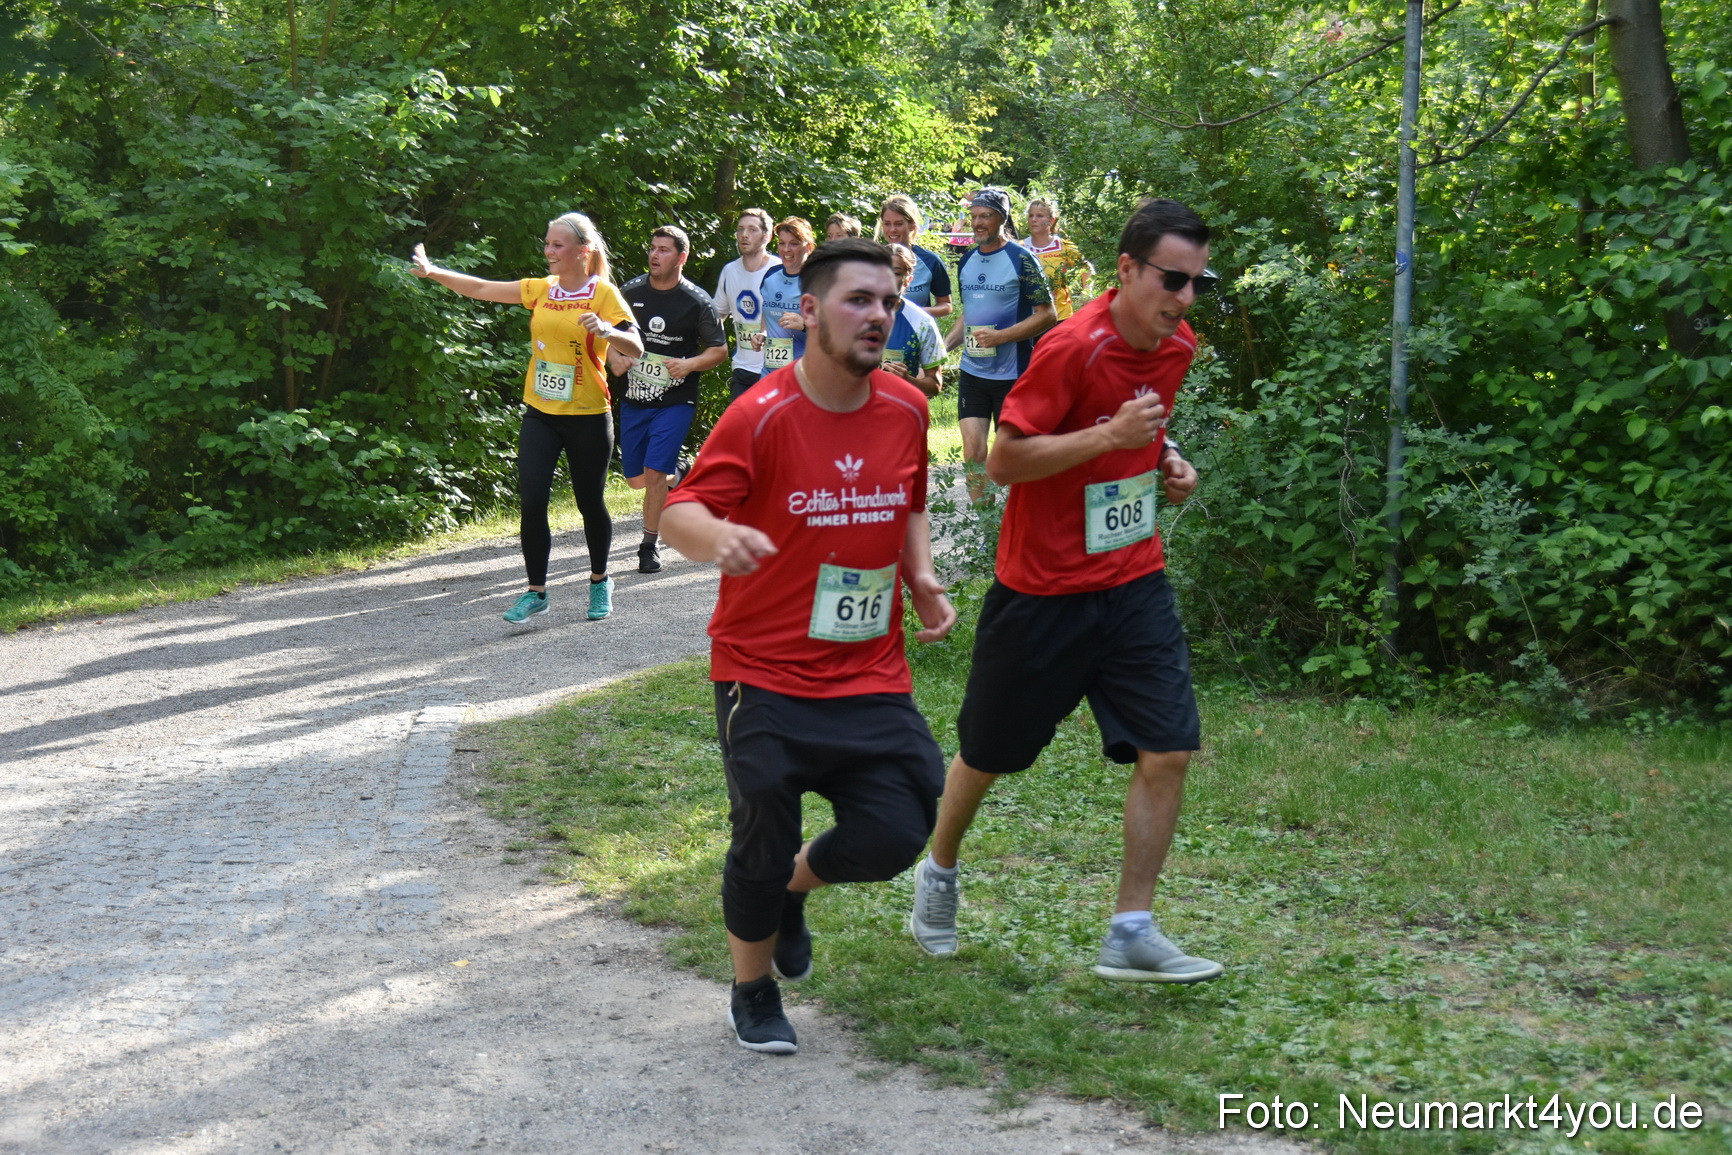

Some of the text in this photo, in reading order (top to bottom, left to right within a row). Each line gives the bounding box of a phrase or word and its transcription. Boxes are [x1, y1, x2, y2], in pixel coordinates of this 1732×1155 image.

[543, 302, 591, 311] MAX BÖGL
[766, 348, 789, 361] 2122
[639, 361, 662, 377] 103
[537, 372, 567, 391] 1559
[788, 483, 907, 515] Echtes Handwerk
[806, 510, 895, 527] IMMER FRISCH
[1105, 499, 1143, 531] 608
[836, 593, 882, 622] 616
